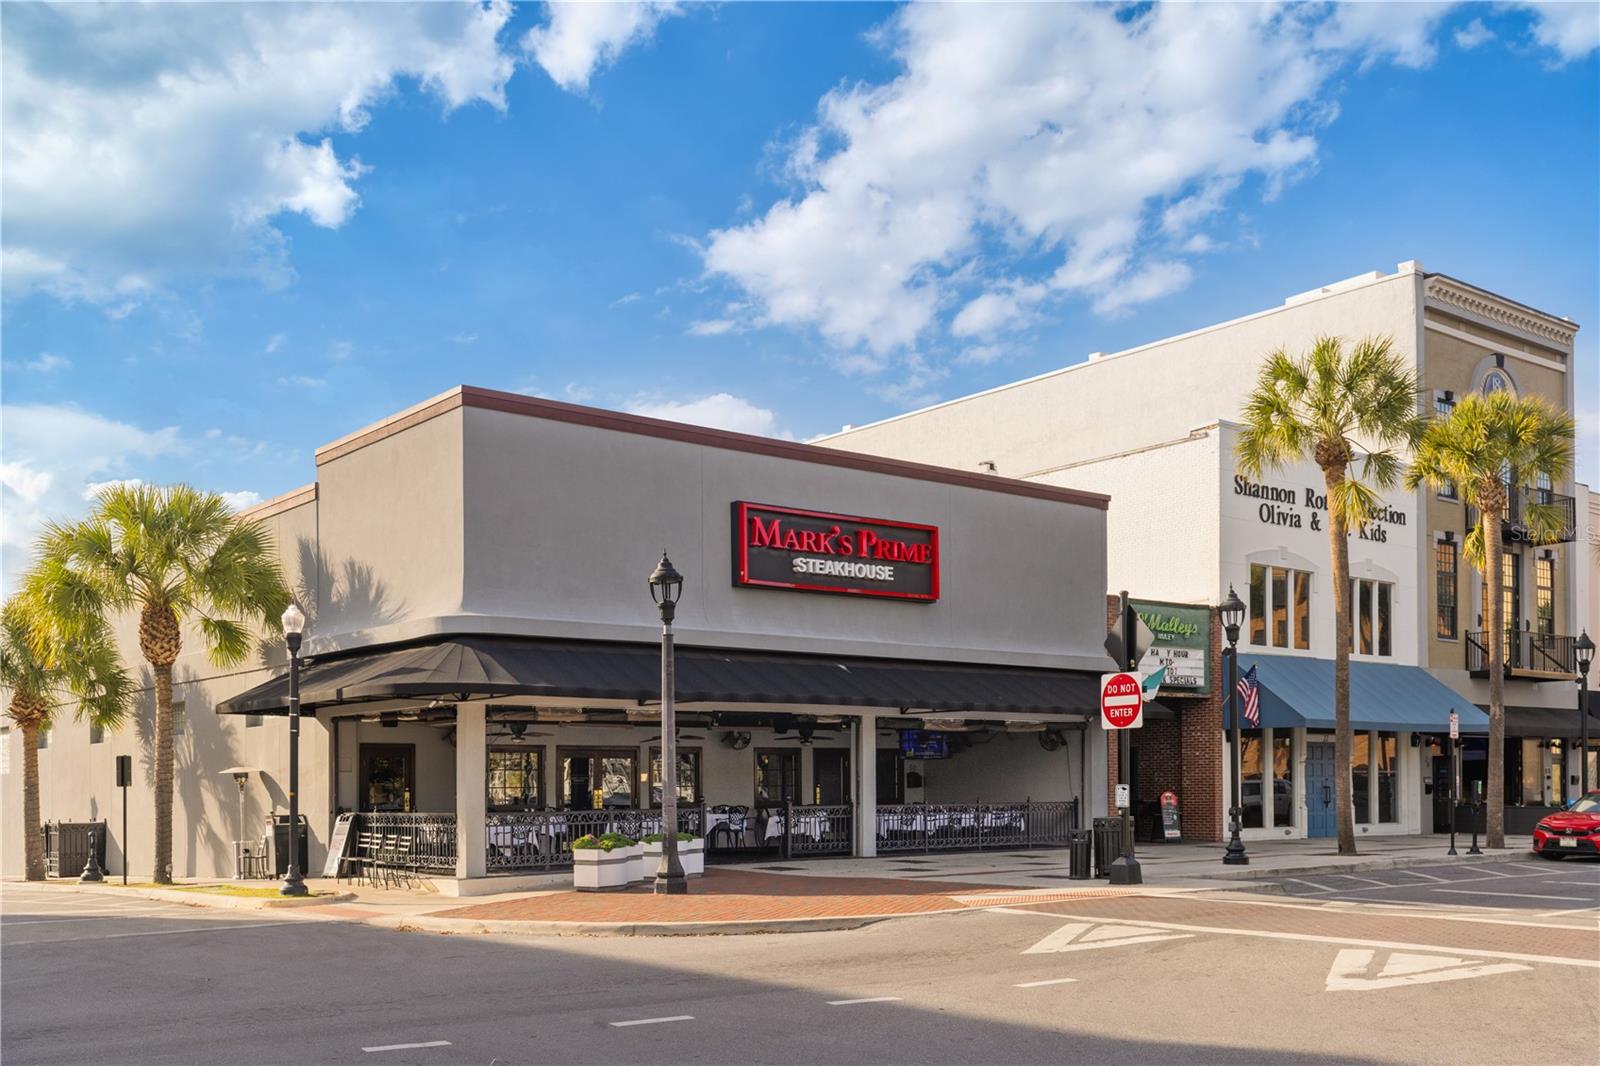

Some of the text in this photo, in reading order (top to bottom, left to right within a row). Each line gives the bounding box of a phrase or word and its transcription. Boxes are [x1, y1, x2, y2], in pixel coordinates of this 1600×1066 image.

[1234, 474, 1296, 505] Shannon
[1304, 487, 1329, 511] Rot
[1259, 502, 1387, 543] Olivia & Kids
[855, 528, 932, 564] PRIME
[792, 557, 895, 581] STEAKHOUSE
[1173, 649, 1189, 659] HOUR
[1107, 683, 1136, 695] DO NOT
[1169, 676, 1197, 686] SPECIALS
[1110, 707, 1134, 718] ENTER
